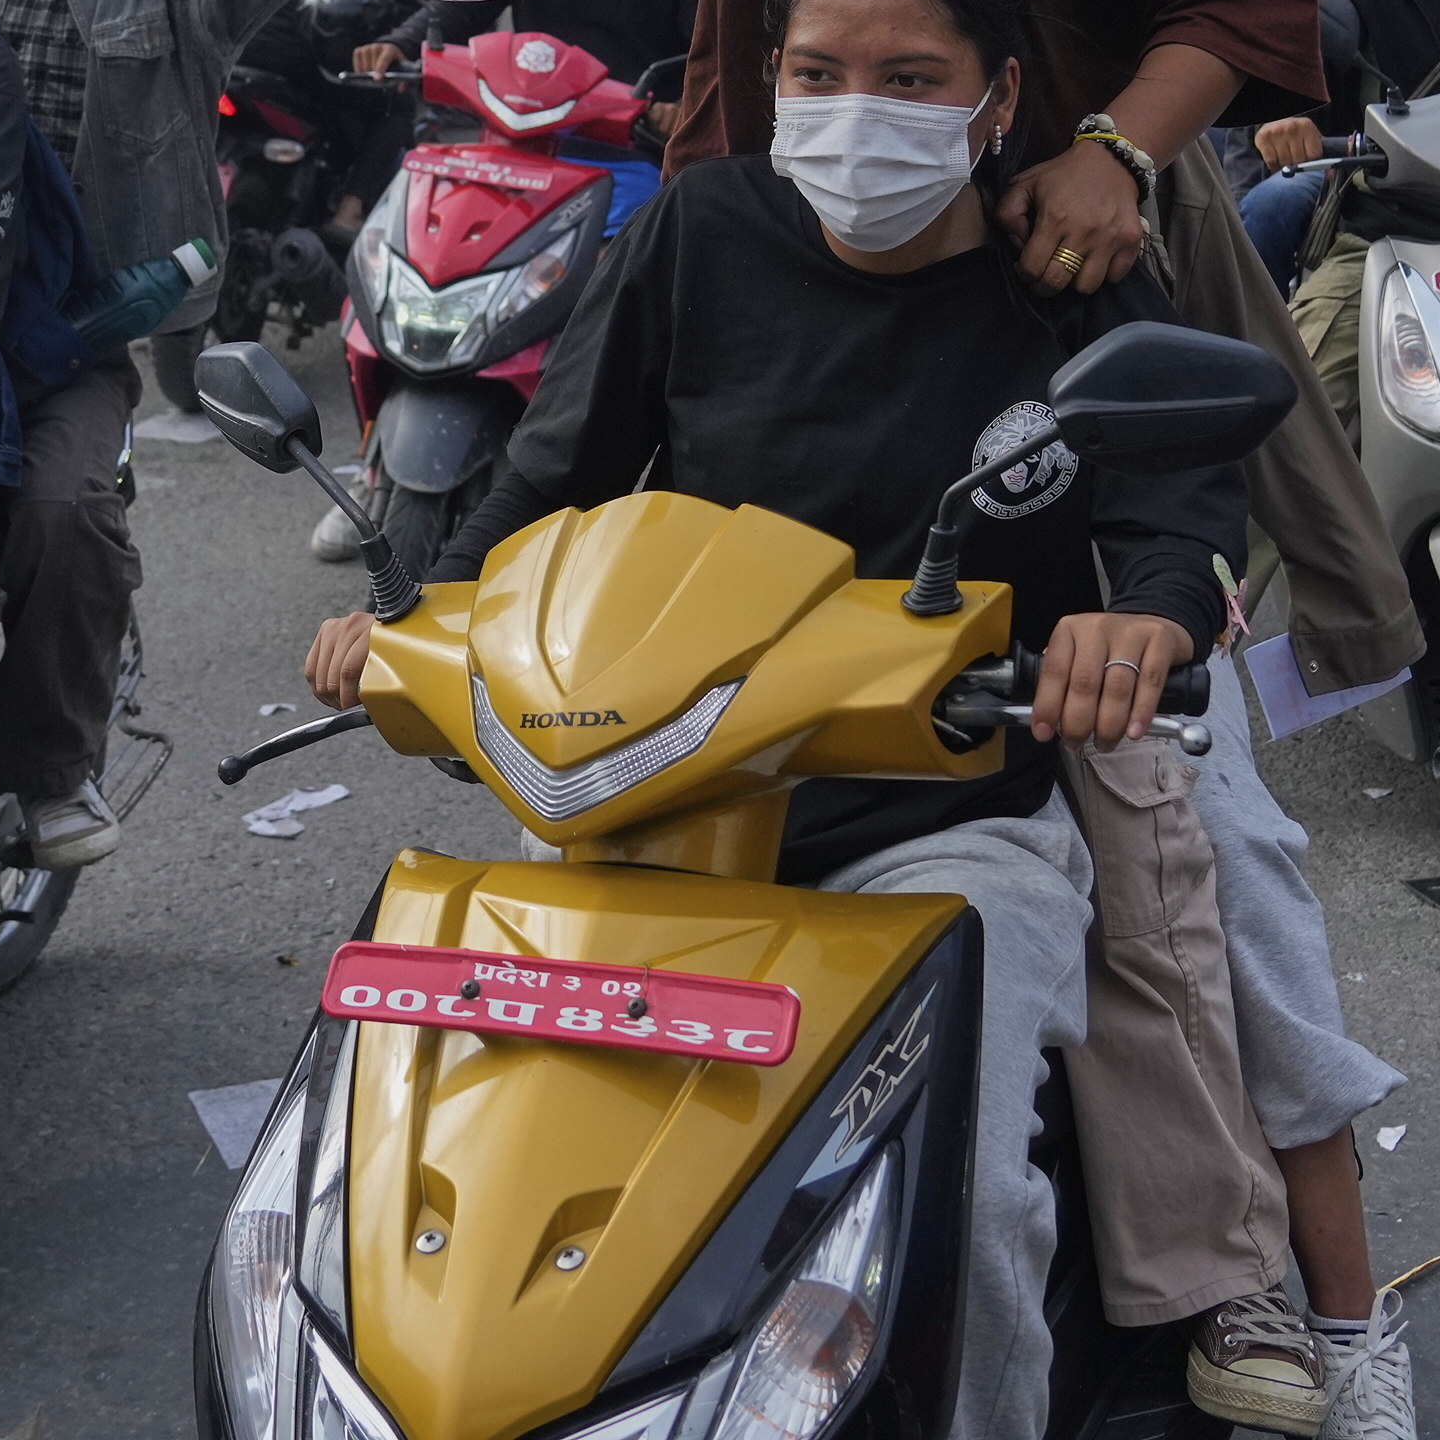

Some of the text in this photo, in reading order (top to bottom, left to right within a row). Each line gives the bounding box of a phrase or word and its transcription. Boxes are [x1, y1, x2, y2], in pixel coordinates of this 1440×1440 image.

[520, 710, 626, 729] HONDA
[473, 959, 551, 990] प्रदेश
[562, 973, 582, 992] ३
